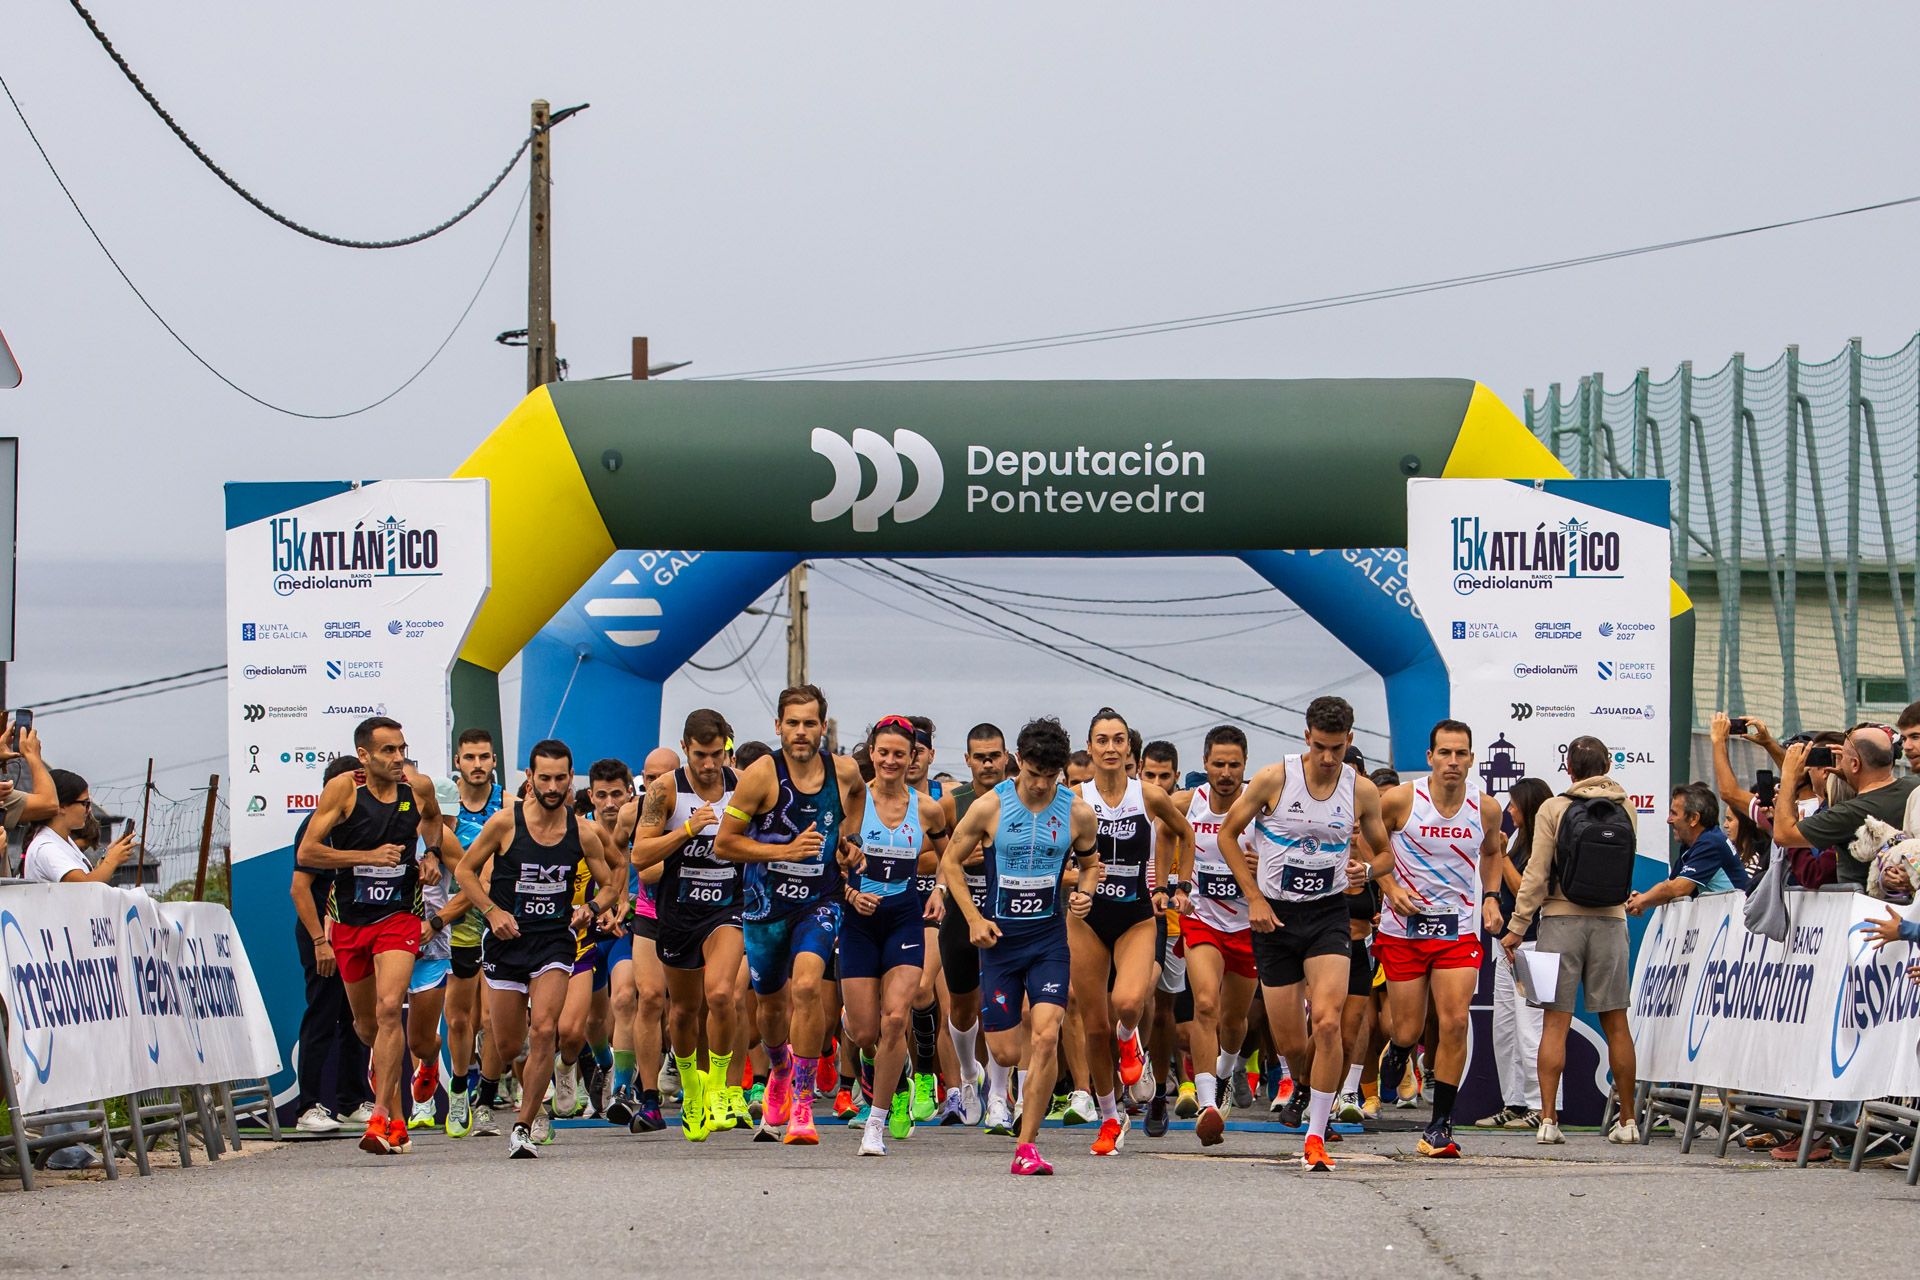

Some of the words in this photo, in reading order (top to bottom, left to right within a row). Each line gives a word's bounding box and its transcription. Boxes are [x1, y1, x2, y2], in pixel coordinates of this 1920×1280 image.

[967, 440, 1206, 485] Deputación
[967, 485, 1205, 513] Pontevedra
[269, 517, 307, 572] 15k
[1450, 517, 1488, 571] 15k
[278, 575, 372, 591] mediolanum
[1458, 576, 1552, 590] mediolanum
[405, 620, 444, 629] Xacobeo
[1616, 622, 1656, 632] Xacobeo
[272, 631, 308, 639] GALICIA
[406, 630, 424, 638] 2027
[246, 666, 307, 675] mediolanum
[1516, 665, 1578, 675] mediolanum
[287, 794, 319, 808] FROI
[1418, 825, 1473, 839] TREGA
[520, 862, 572, 883] EKT
[884, 866, 892, 879] 1
[776, 883, 810, 899] 429
[916, 880, 936, 892] 33
[1096, 882, 1126, 898] 666
[1207, 882, 1236, 896] 538
[1292, 876, 1324, 892] 323
[368, 886, 394, 900] 107
[689, 888, 722, 902] 460
[524, 901, 556, 914] 503
[1010, 898, 1043, 914] 522
[90, 916, 116, 948] BANCO
[1417, 922, 1448, 936] 373
[1792, 926, 1824, 956] BANCO
[11, 926, 128, 1030] mediolanum
[1696, 931, 1815, 1024] mediolanum
